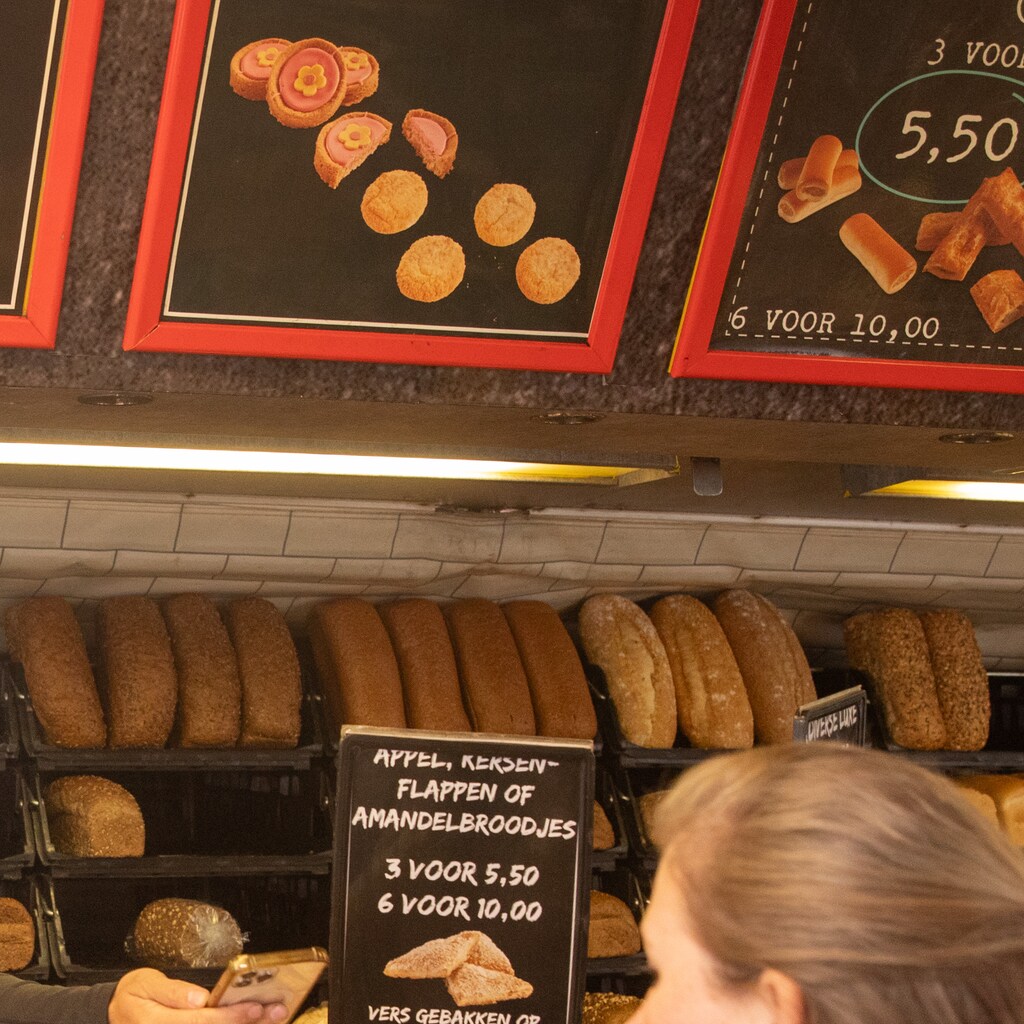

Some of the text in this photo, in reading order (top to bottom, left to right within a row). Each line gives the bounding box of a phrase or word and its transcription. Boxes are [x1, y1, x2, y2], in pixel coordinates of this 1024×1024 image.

[927, 38, 945, 65] 3
[896, 111, 1018, 164] 5,50
[731, 306, 940, 342] 6 VOOR 10,00
[373, 749, 452, 771] APPEL,
[397, 779, 535, 806] FLAPPEN OF
[352, 806, 576, 840] AMANDELBROODJES
[385, 859, 539, 887] 3 VOOR 5,50
[378, 893, 542, 922] 6 VOOR 10,00
[369, 1006, 411, 1024] VERS
